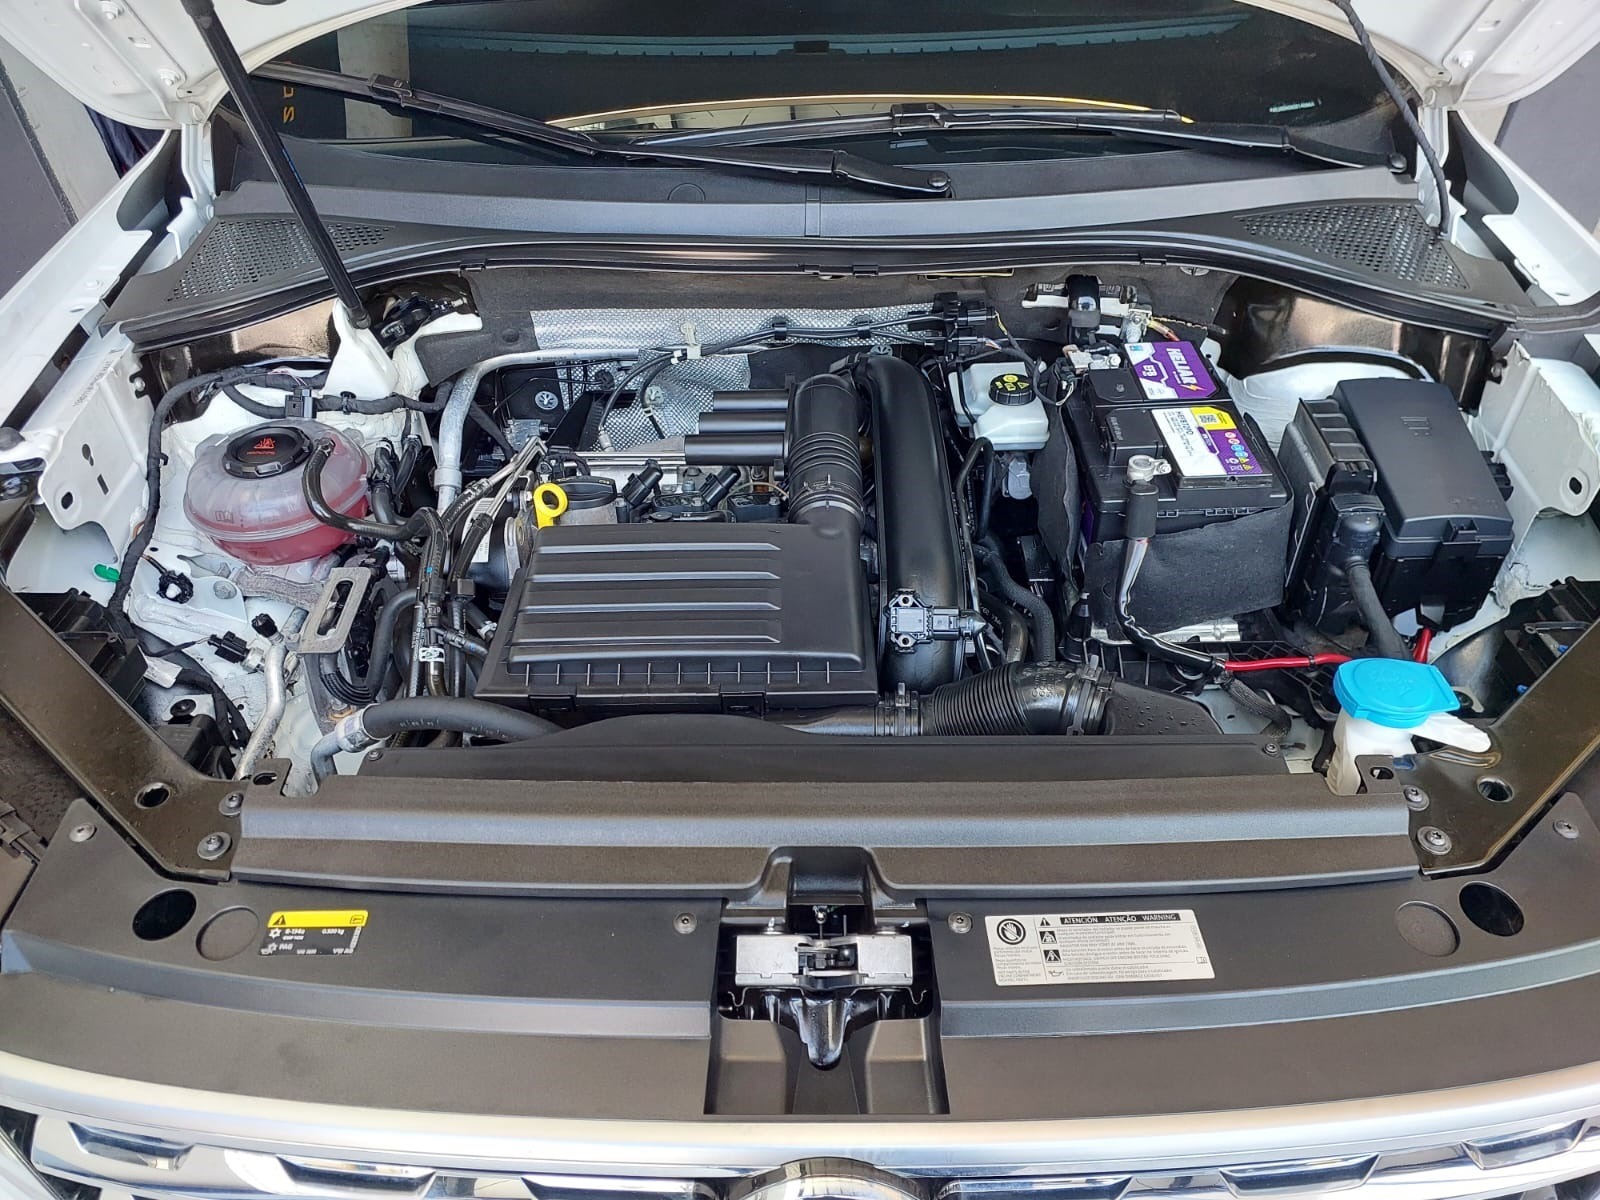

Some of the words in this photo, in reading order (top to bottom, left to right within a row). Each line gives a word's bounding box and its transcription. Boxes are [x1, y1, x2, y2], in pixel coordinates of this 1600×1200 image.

[1143, 364, 1158, 377] EFB
[1166, 348, 1198, 384] HELIAR
[1104, 914, 1137, 923] ATENÇÃO
[1142, 913, 1177, 921] WARNING
